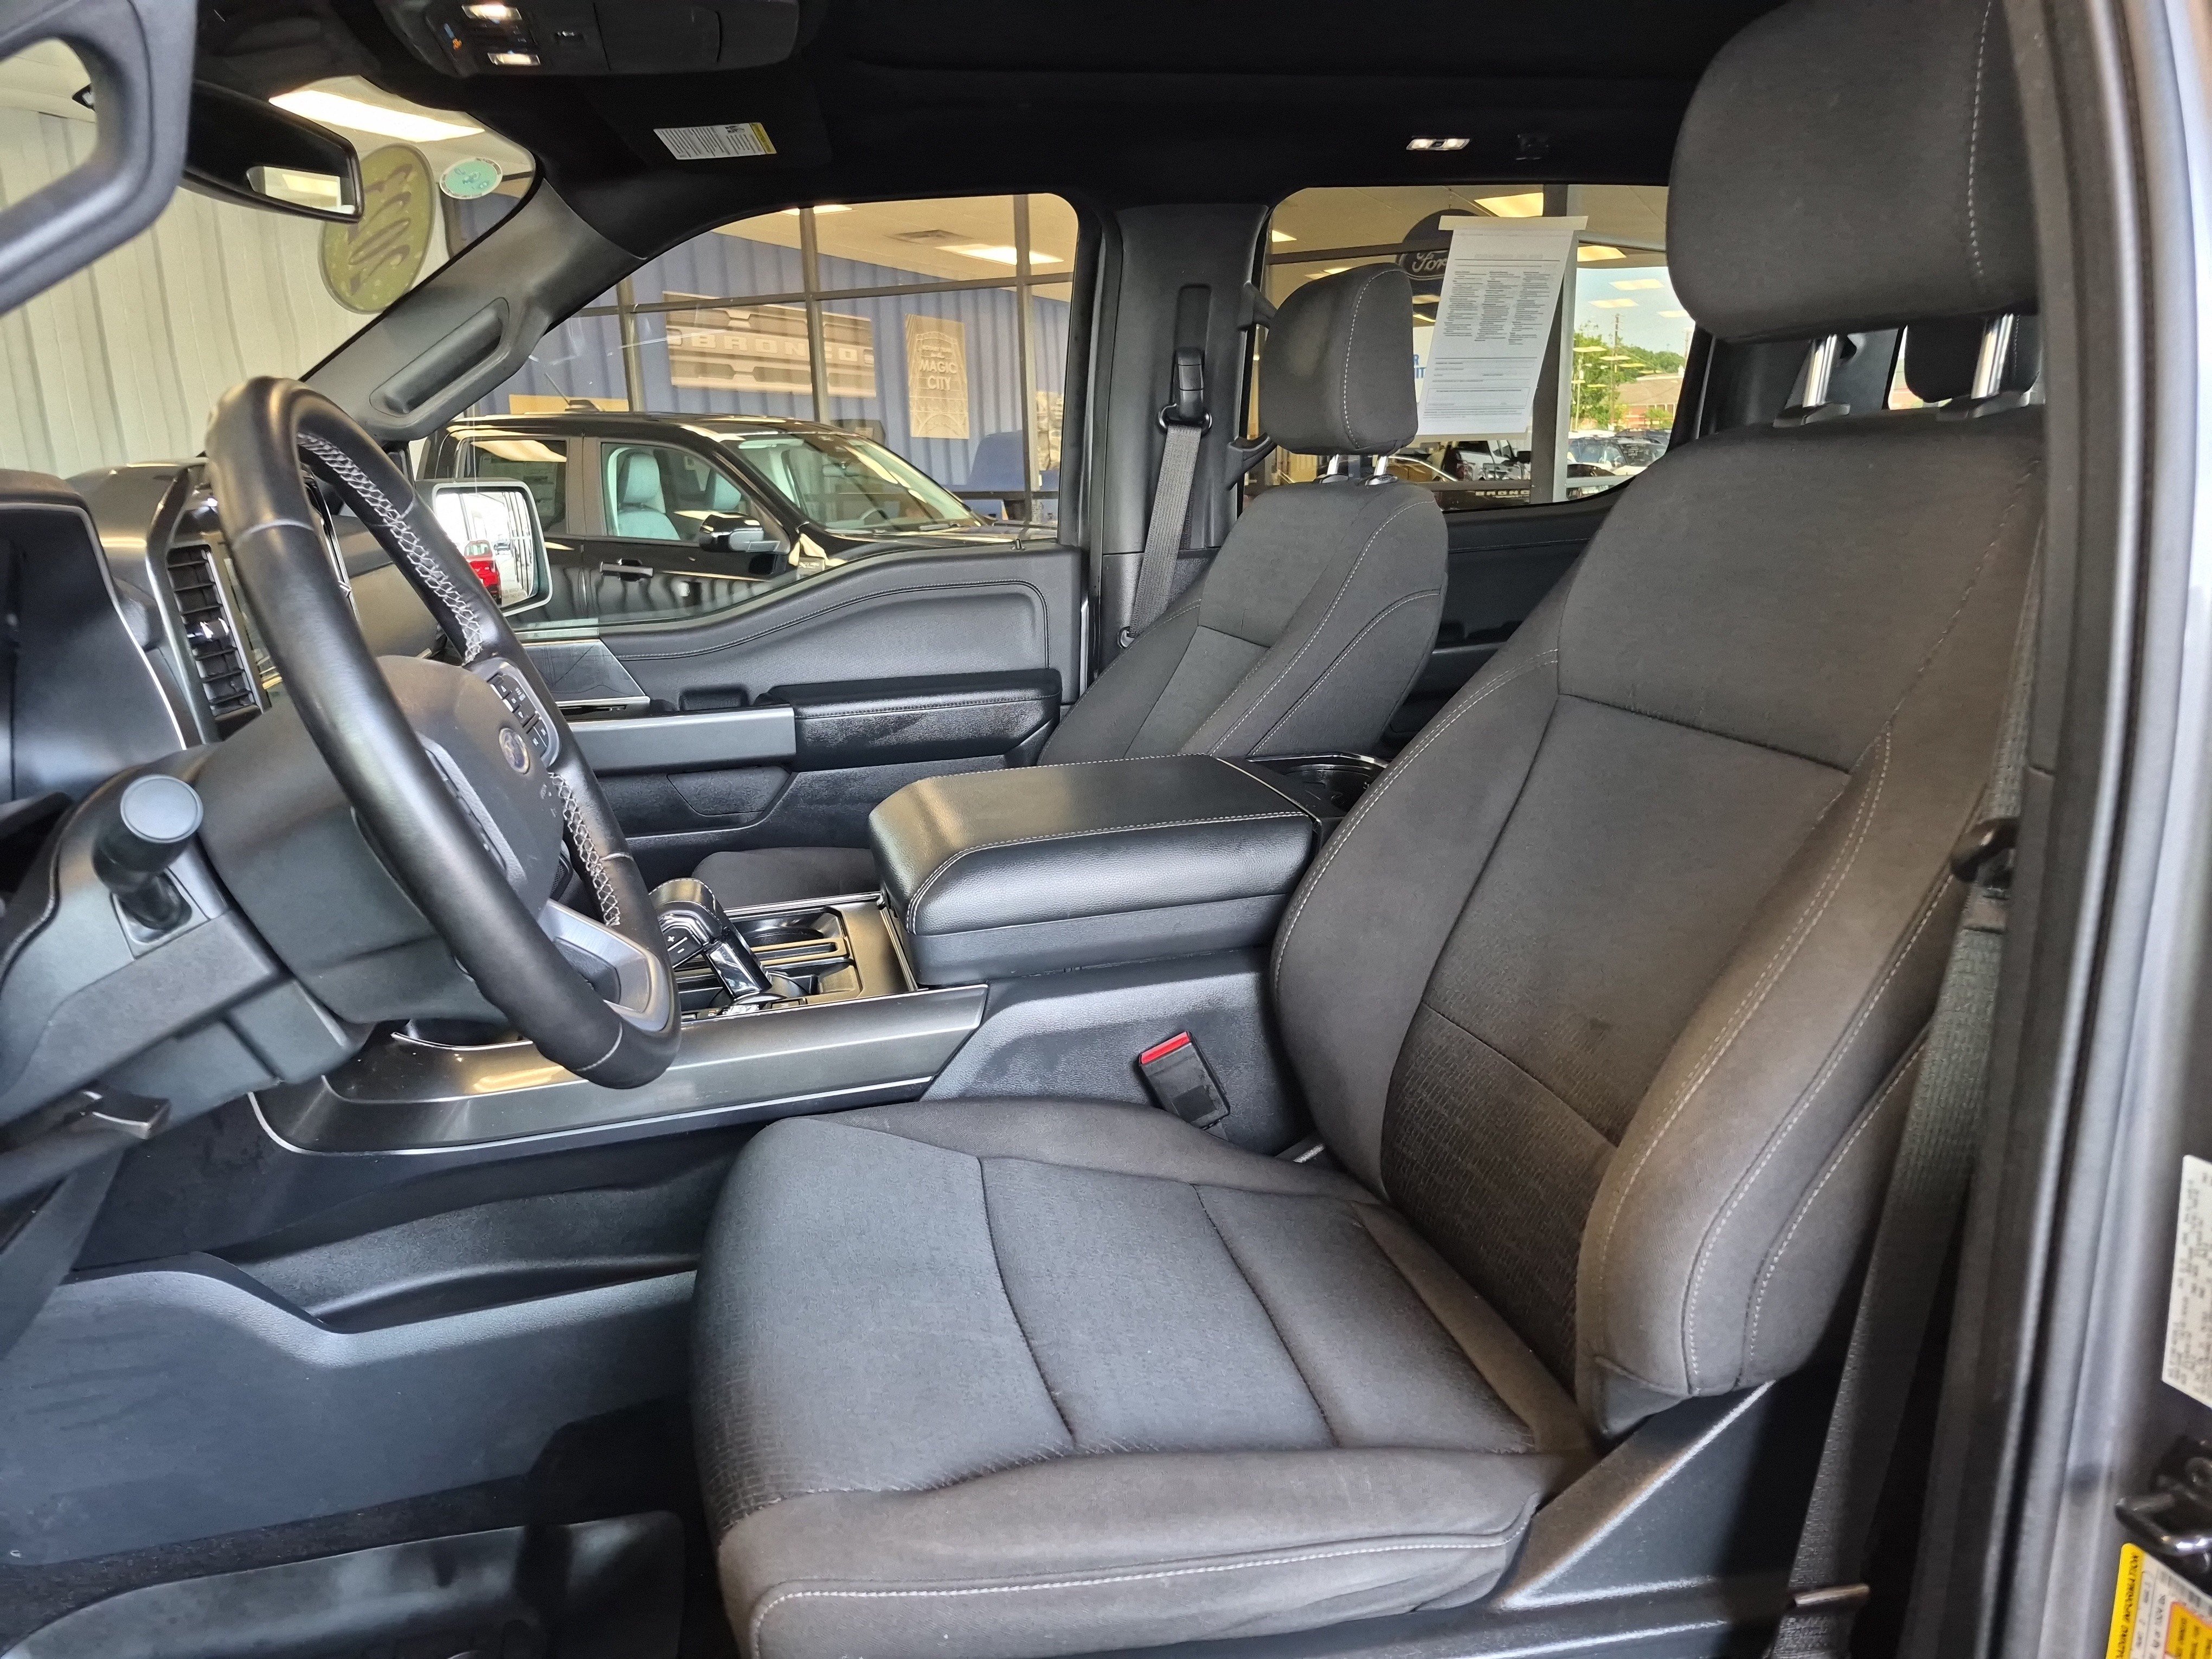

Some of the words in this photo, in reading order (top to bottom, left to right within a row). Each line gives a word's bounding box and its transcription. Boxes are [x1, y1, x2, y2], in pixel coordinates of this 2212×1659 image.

[1412, 250, 1448, 273] For
[919, 359, 959, 374] MAGIC
[927, 375, 951, 390] CITY
